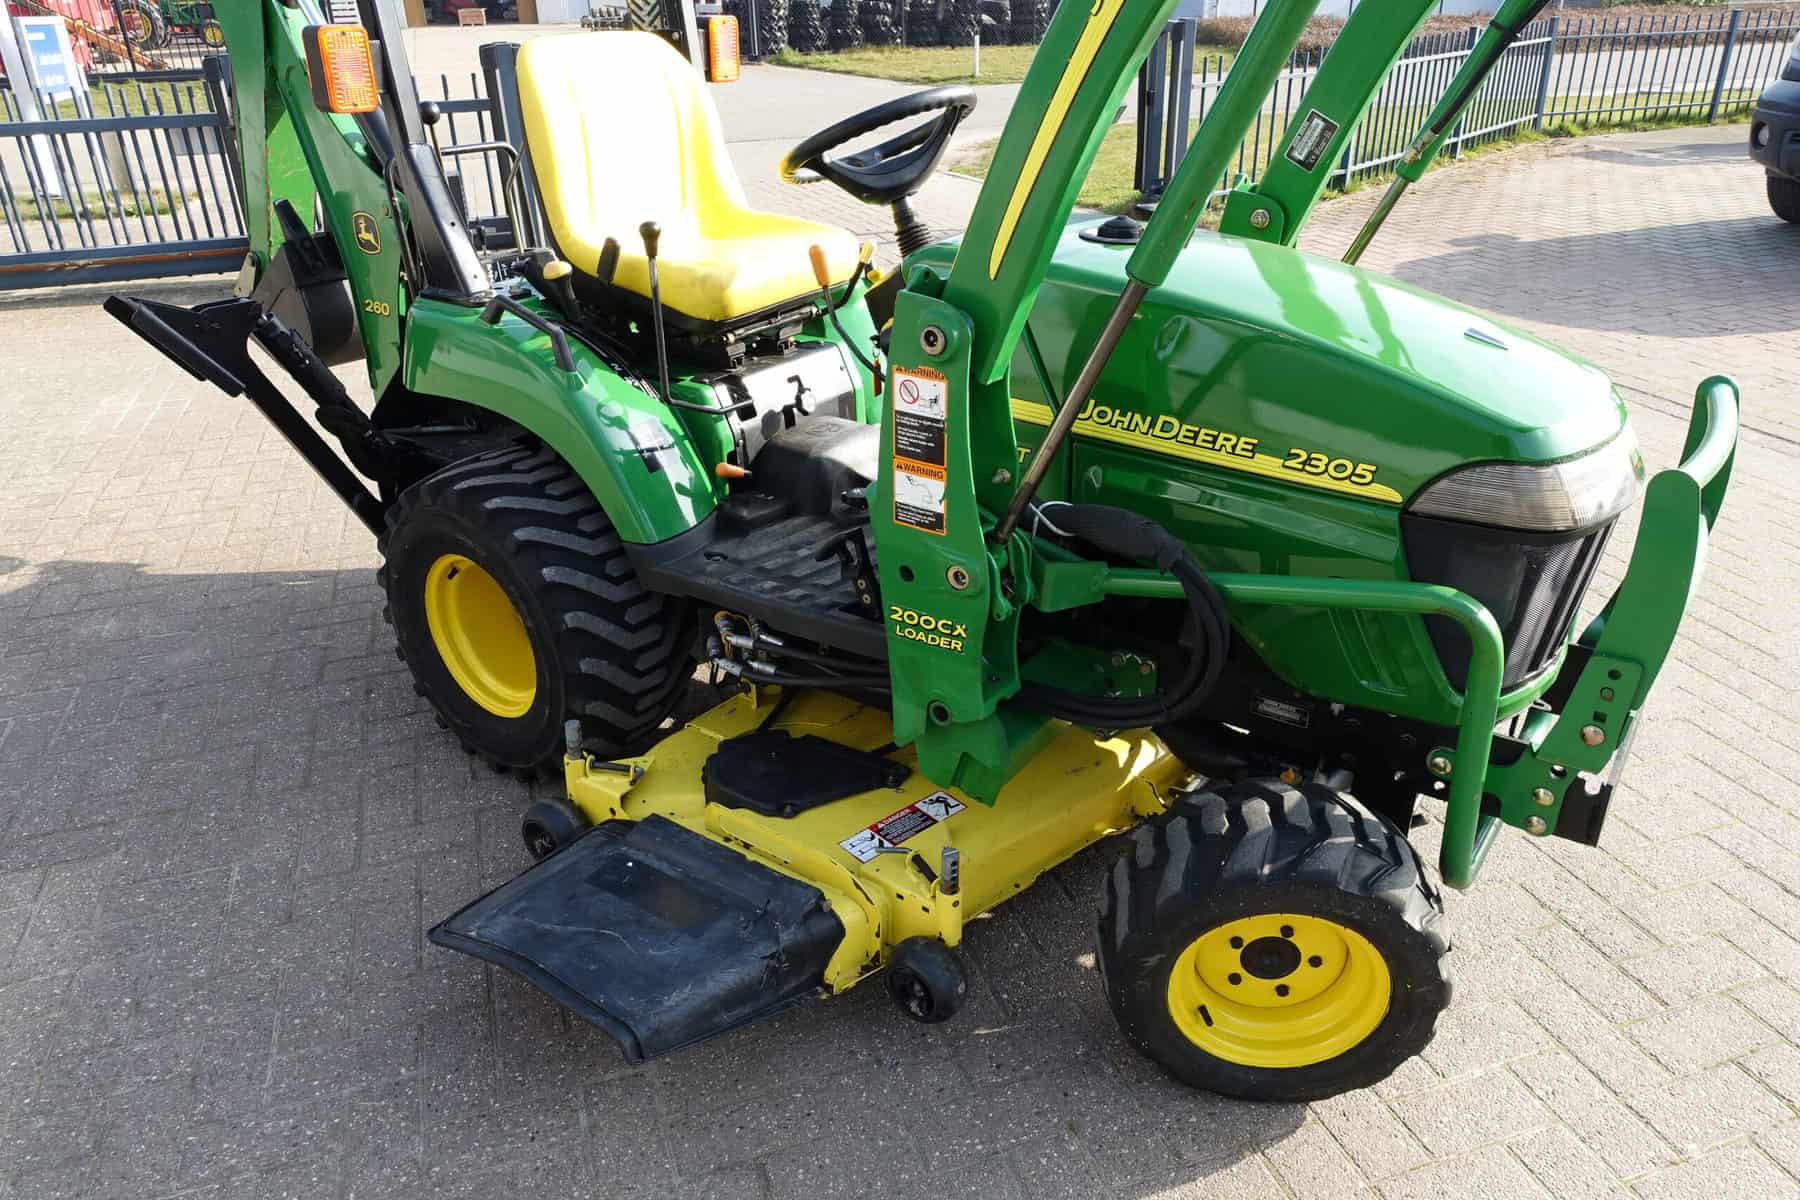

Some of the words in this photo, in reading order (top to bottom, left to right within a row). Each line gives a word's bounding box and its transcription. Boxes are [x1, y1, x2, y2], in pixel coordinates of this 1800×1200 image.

[364, 299, 390, 316] 260
[1077, 399, 1152, 436] JOHN
[1151, 414, 1259, 459] DEERE
[903, 463, 944, 480] WARNING
[1282, 447, 1377, 486] 2305
[889, 605, 967, 638] 200CX
[895, 623, 963, 652] LOADER
